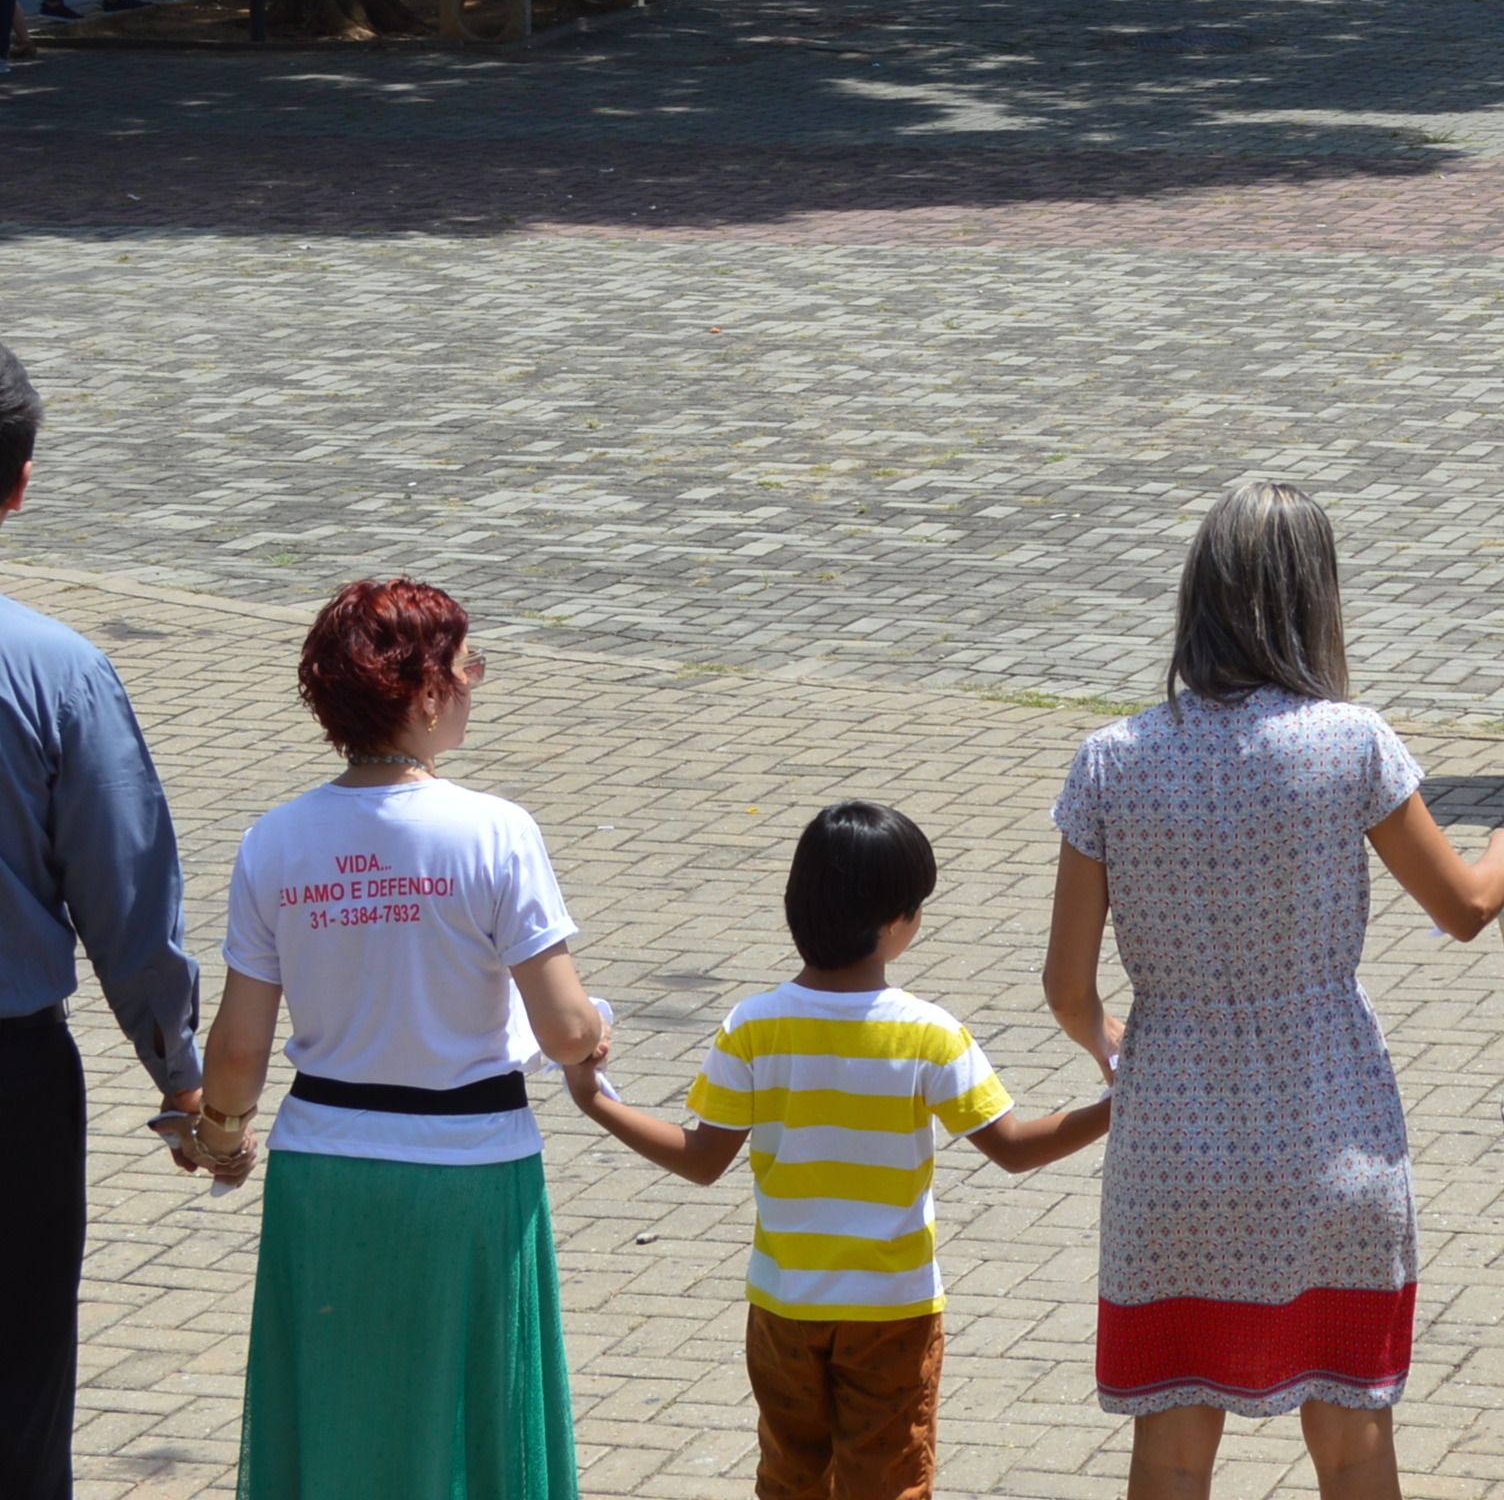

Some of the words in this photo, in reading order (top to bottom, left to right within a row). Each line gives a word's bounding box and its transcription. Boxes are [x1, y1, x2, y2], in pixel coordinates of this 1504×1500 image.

[335, 853, 392, 874] VIDA...
[303, 883, 345, 904] AMO
[351, 882, 362, 900] E
[367, 877, 454, 899] DEFENDO!
[340, 903, 420, 927] 3384-7932
